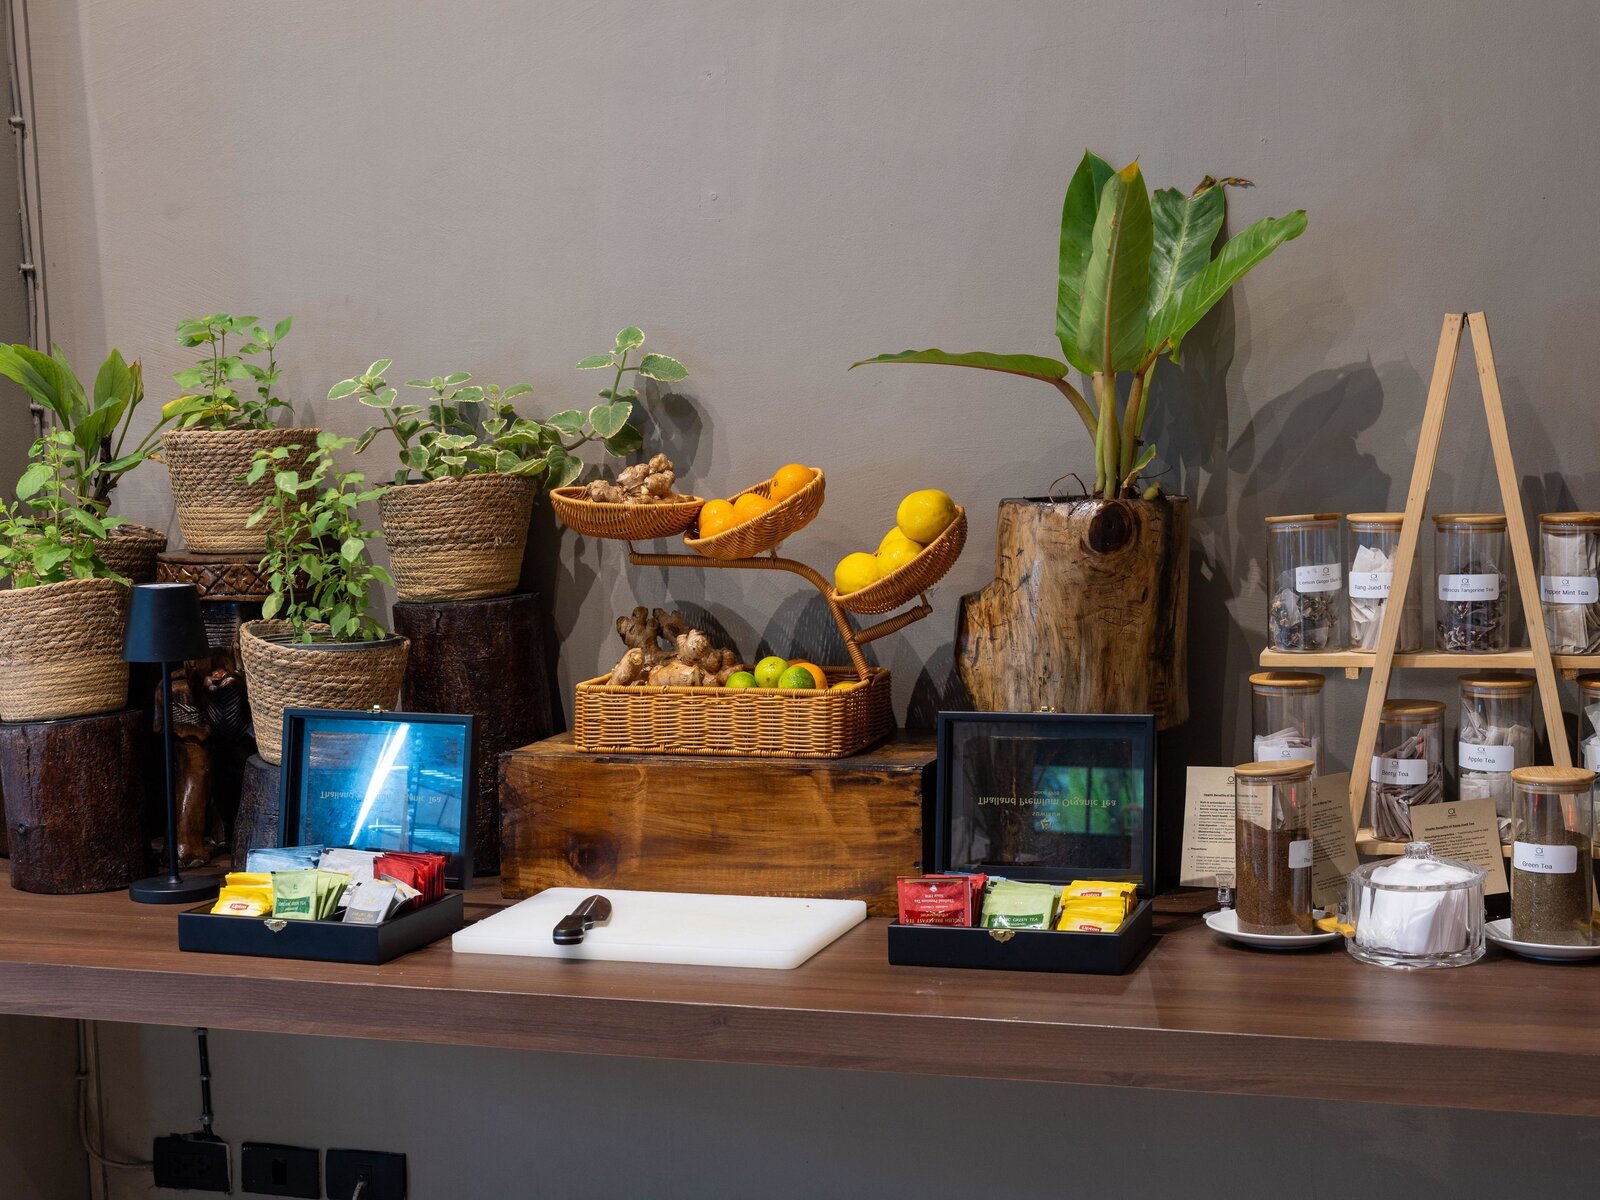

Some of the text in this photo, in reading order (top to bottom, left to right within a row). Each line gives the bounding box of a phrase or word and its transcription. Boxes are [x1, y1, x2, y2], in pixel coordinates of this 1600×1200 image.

[1367, 584, 1382, 592] Jued
[1544, 589, 1561, 597] Pepper
[1577, 589, 1589, 597] Tea
[1467, 755, 1483, 764] Apple
[1381, 769, 1397, 778] Berry
[1521, 860, 1553, 870] Green Tea
